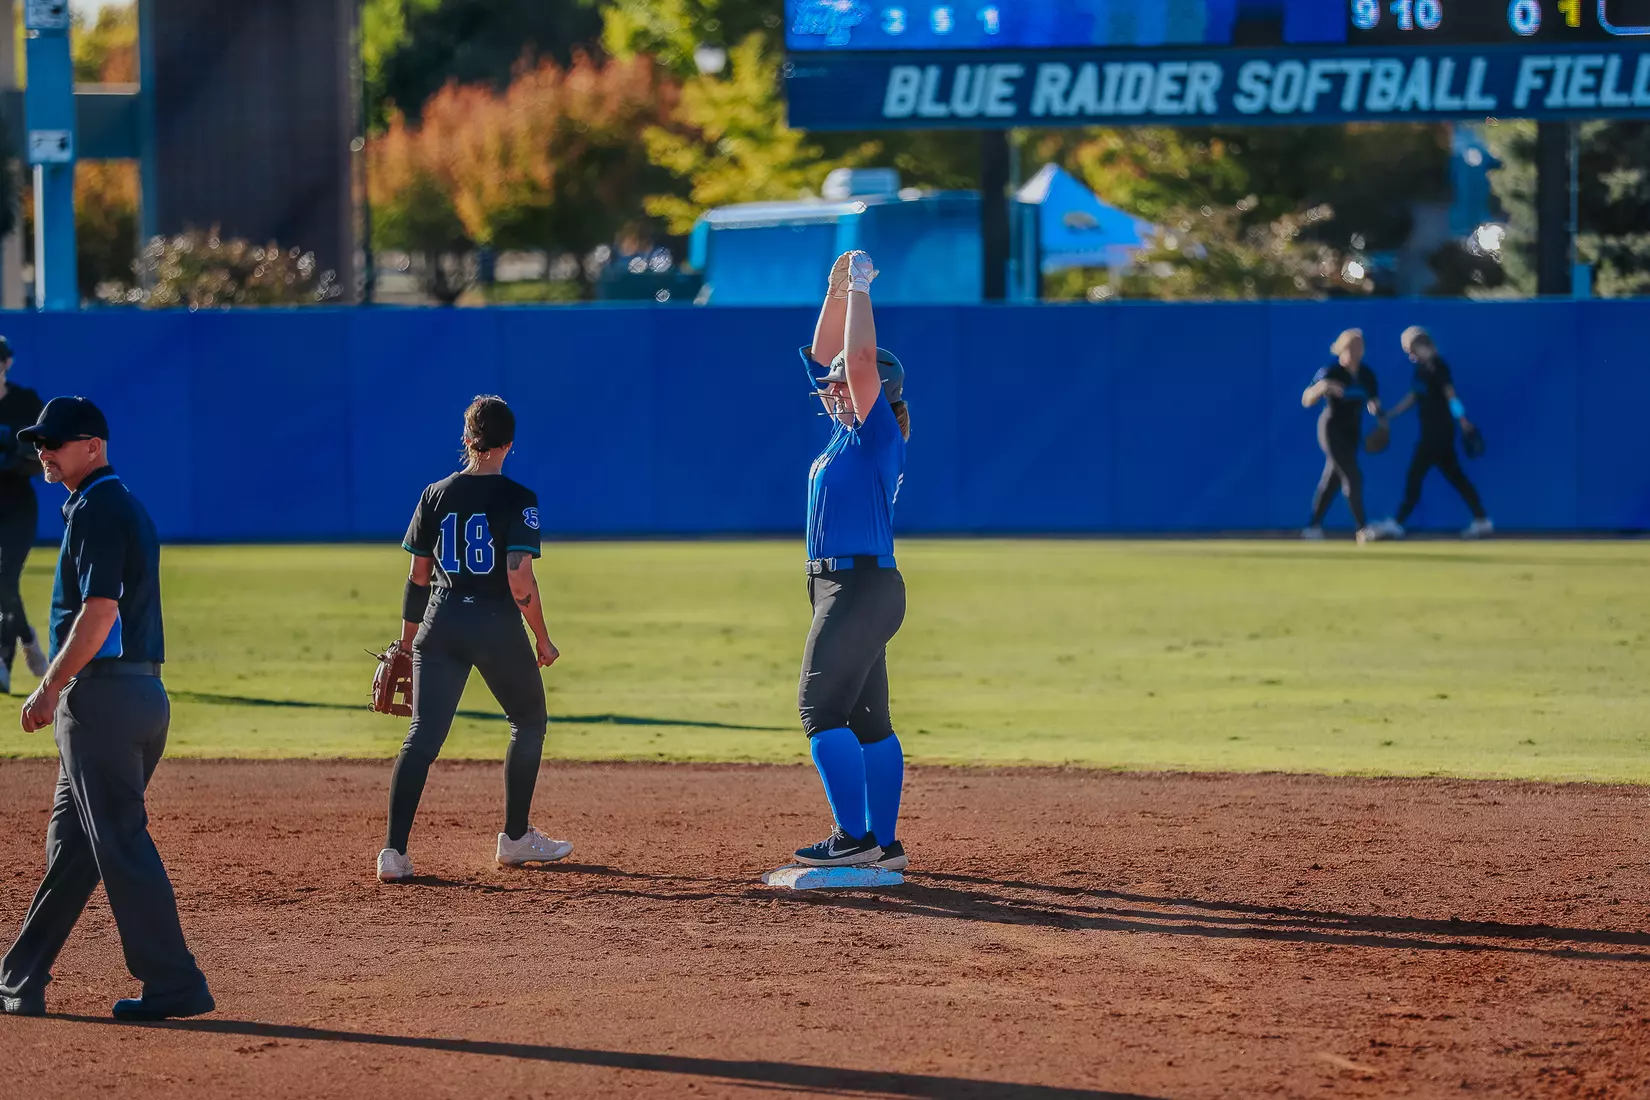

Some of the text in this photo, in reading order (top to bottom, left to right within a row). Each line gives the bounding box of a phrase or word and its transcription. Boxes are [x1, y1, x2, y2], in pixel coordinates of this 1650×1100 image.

[976, 6, 1000, 35] 1
[1351, 0, 1380, 30] 9
[1389, 0, 1442, 30] 10
[1507, 0, 1541, 36] 0
[883, 64, 1024, 118] BLUE
[1030, 61, 1222, 116] RAIDER
[1233, 56, 1497, 114] SOFTBALL
[440, 513, 495, 575] 18
